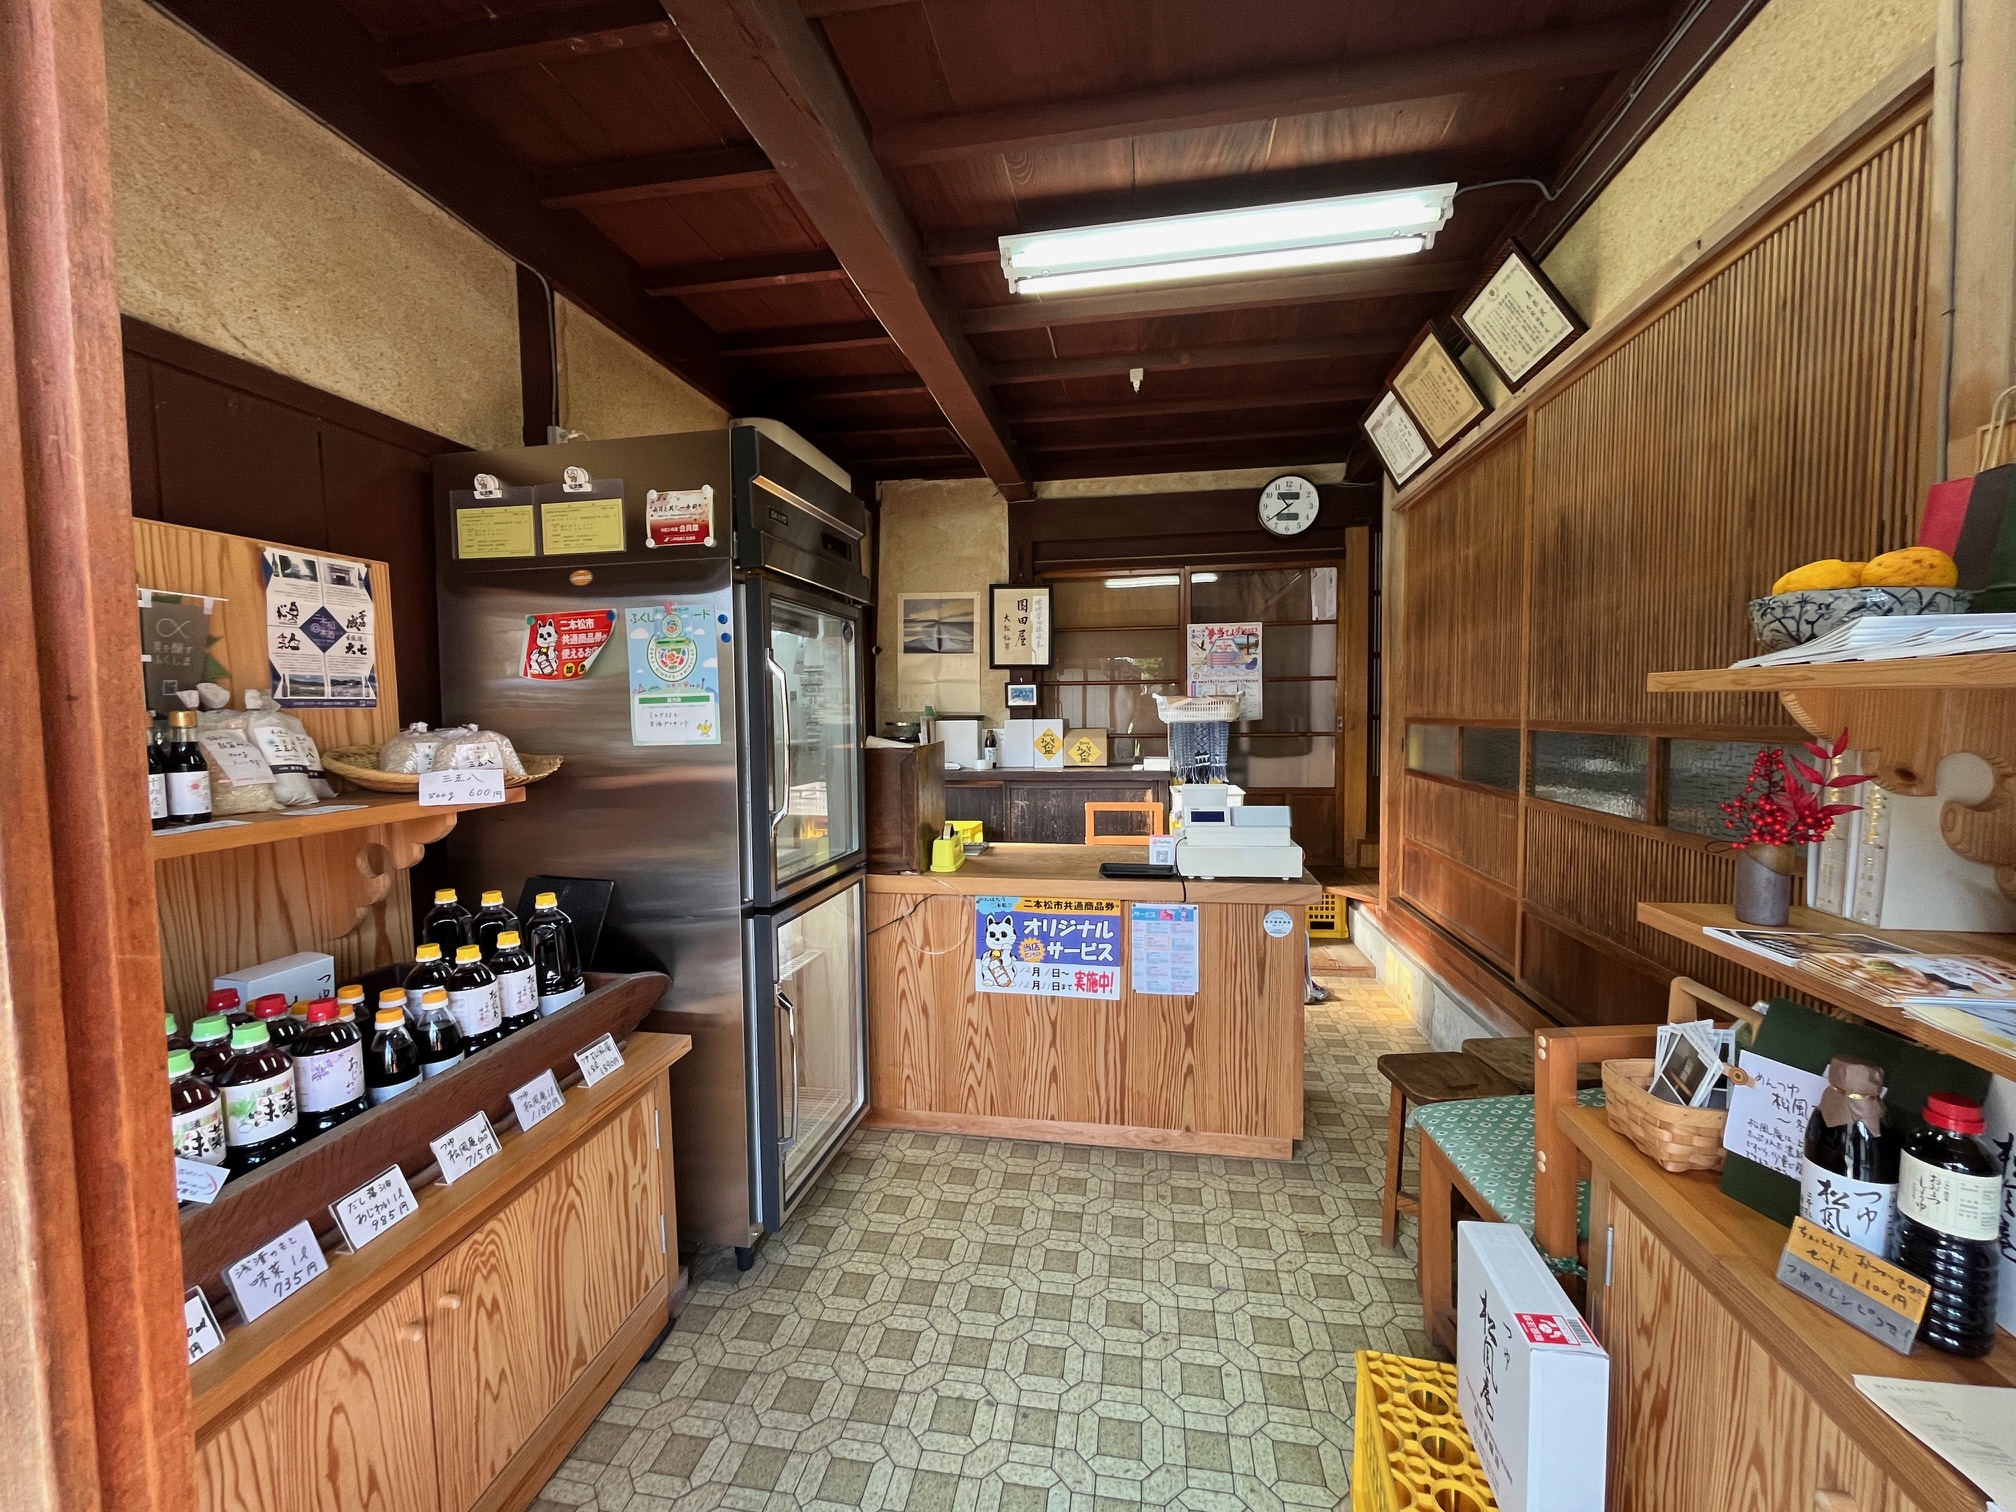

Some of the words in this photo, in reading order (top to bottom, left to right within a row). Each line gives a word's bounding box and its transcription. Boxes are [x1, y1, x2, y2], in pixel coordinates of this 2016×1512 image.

[1274, 482, 1281, 491] 11
[1285, 480, 1293, 488] 12
[1299, 482, 1303, 491] 1
[1305, 490, 1312, 499] 2
[1262, 502, 1268, 511] 9
[1308, 502, 1314, 510] 3
[1304, 513, 1310, 521] 4
[1273, 522, 1279, 530] 7
[1284, 524, 1290, 532] 6
[1296, 521, 1302, 530] 5
[560, 618, 595, 631] 二本松市
[345, 642, 368, 656] 大七
[469, 760, 494, 768] 三五八
[442, 773, 484, 783] 三五八
[468, 788, 502, 799] 600円
[1023, 899, 1115, 912] 二本松市共通商品券
[1023, 917, 1115, 939] オリジナル
[1046, 941, 1114, 962] サービス
[1771, 1092, 1819, 1122] 松風
[465, 1143, 494, 1168] 715円
[371, 1201, 410, 1232] 985円
[1853, 1191, 1883, 1236] つゆ
[249, 1260, 284, 1288] 味菜
[273, 1261, 318, 1298] 735円
